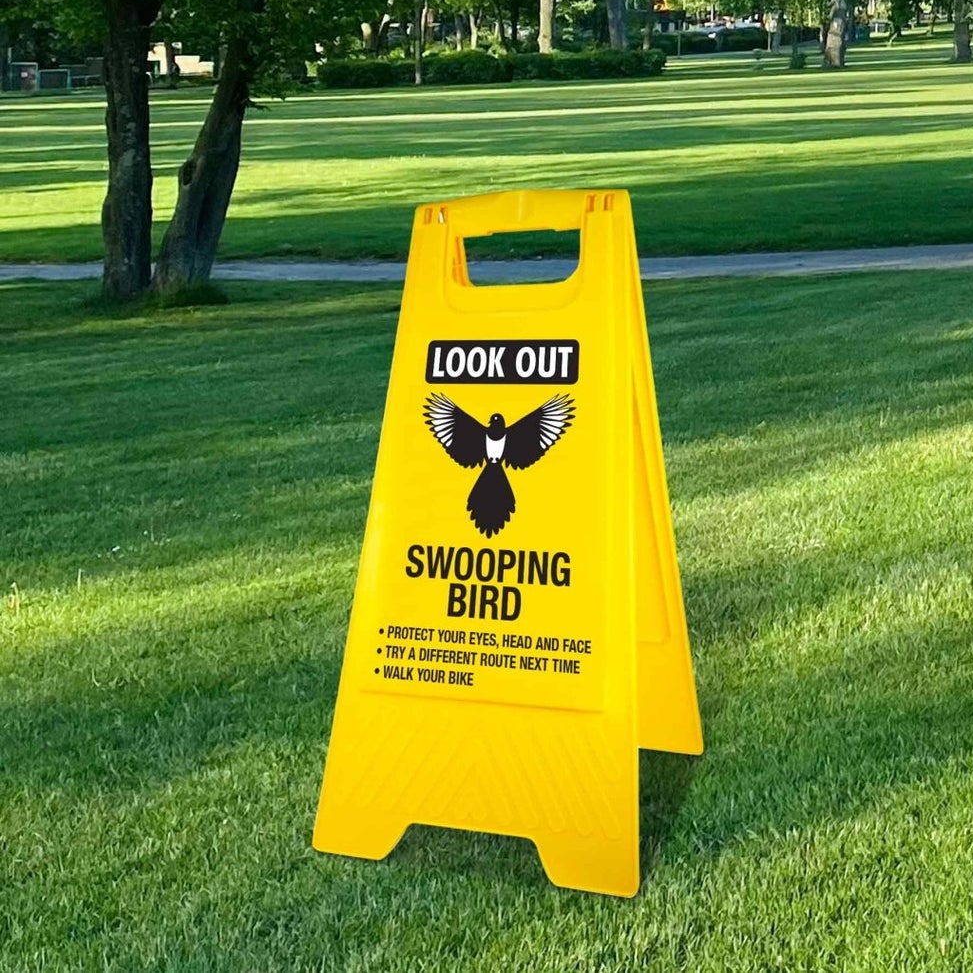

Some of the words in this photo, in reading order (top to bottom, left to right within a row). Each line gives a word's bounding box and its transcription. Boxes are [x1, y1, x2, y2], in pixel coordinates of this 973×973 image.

[432, 347, 505, 378] LOOK
[515, 346, 573, 378] OUT
[405, 544, 571, 587] SWOOPING
[447, 583, 521, 621] BIRD
[387, 626, 435, 641] PROTECT
[438, 629, 466, 644] YOUR
[469, 632, 499, 649] EYES,
[502, 634, 532, 649] HEAD
[535, 637, 559, 651] AND
[563, 639, 591, 654] FACE
[386, 645, 405, 659] TRY
[408, 647, 416, 660] A
[419, 648, 477, 665] DIFFERENT
[480, 653, 516, 669] ROUTE
[520, 656, 549, 671] NEXT
[552, 659, 580, 674] TIME
[383, 665, 414, 680] WALK
[417, 668, 445, 684] YOUR
[449, 671, 474, 686] BIKE
